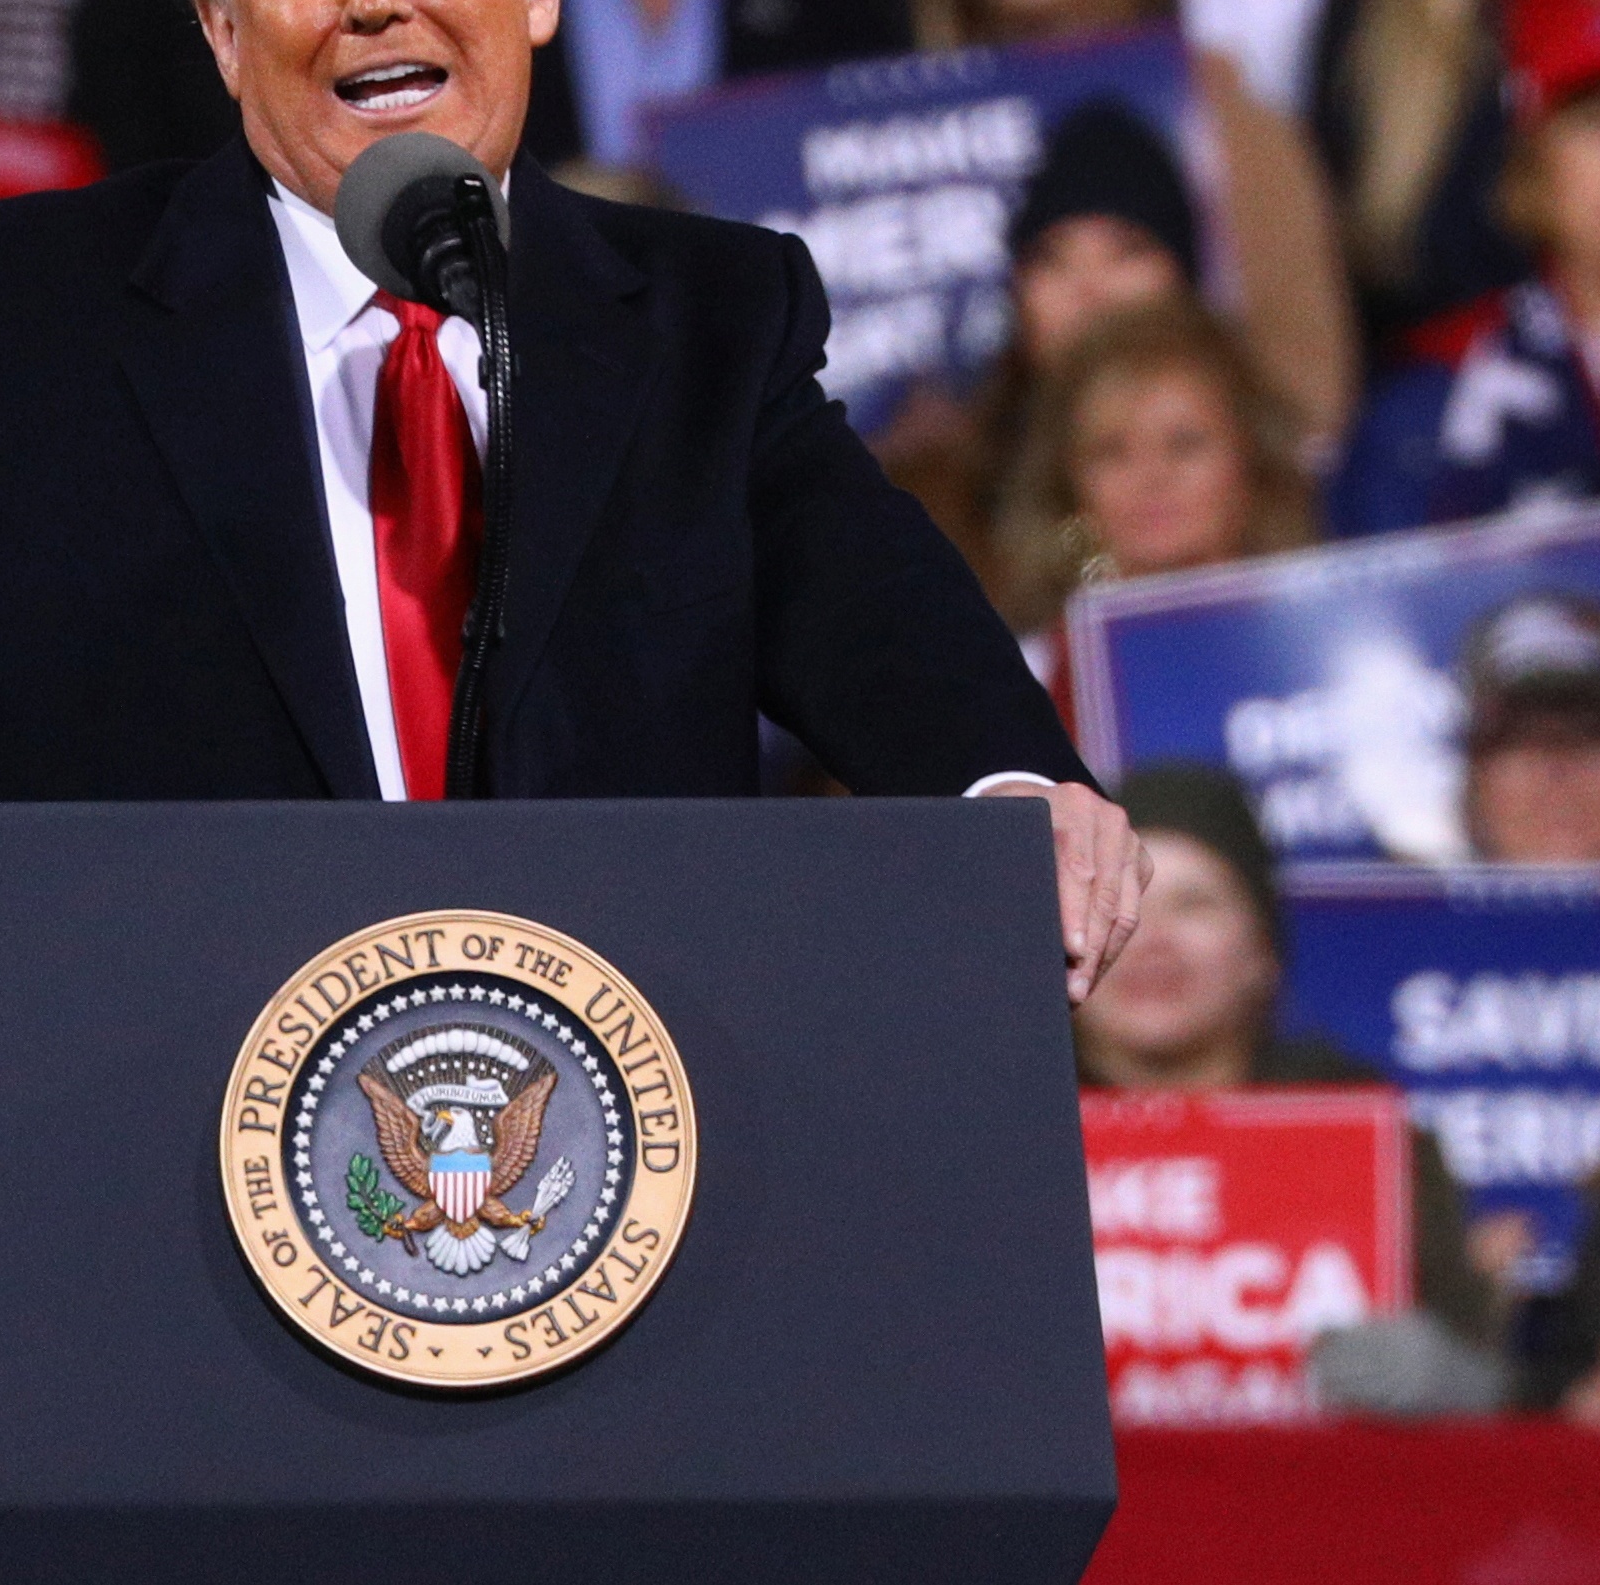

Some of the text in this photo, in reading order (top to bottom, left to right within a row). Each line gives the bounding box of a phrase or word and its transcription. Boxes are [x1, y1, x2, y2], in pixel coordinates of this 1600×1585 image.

[238, 928, 682, 1364] SEAL OF THE PRESIDENT OF THE UNITED STATES
[1095, 1242, 1371, 1348] RICA
